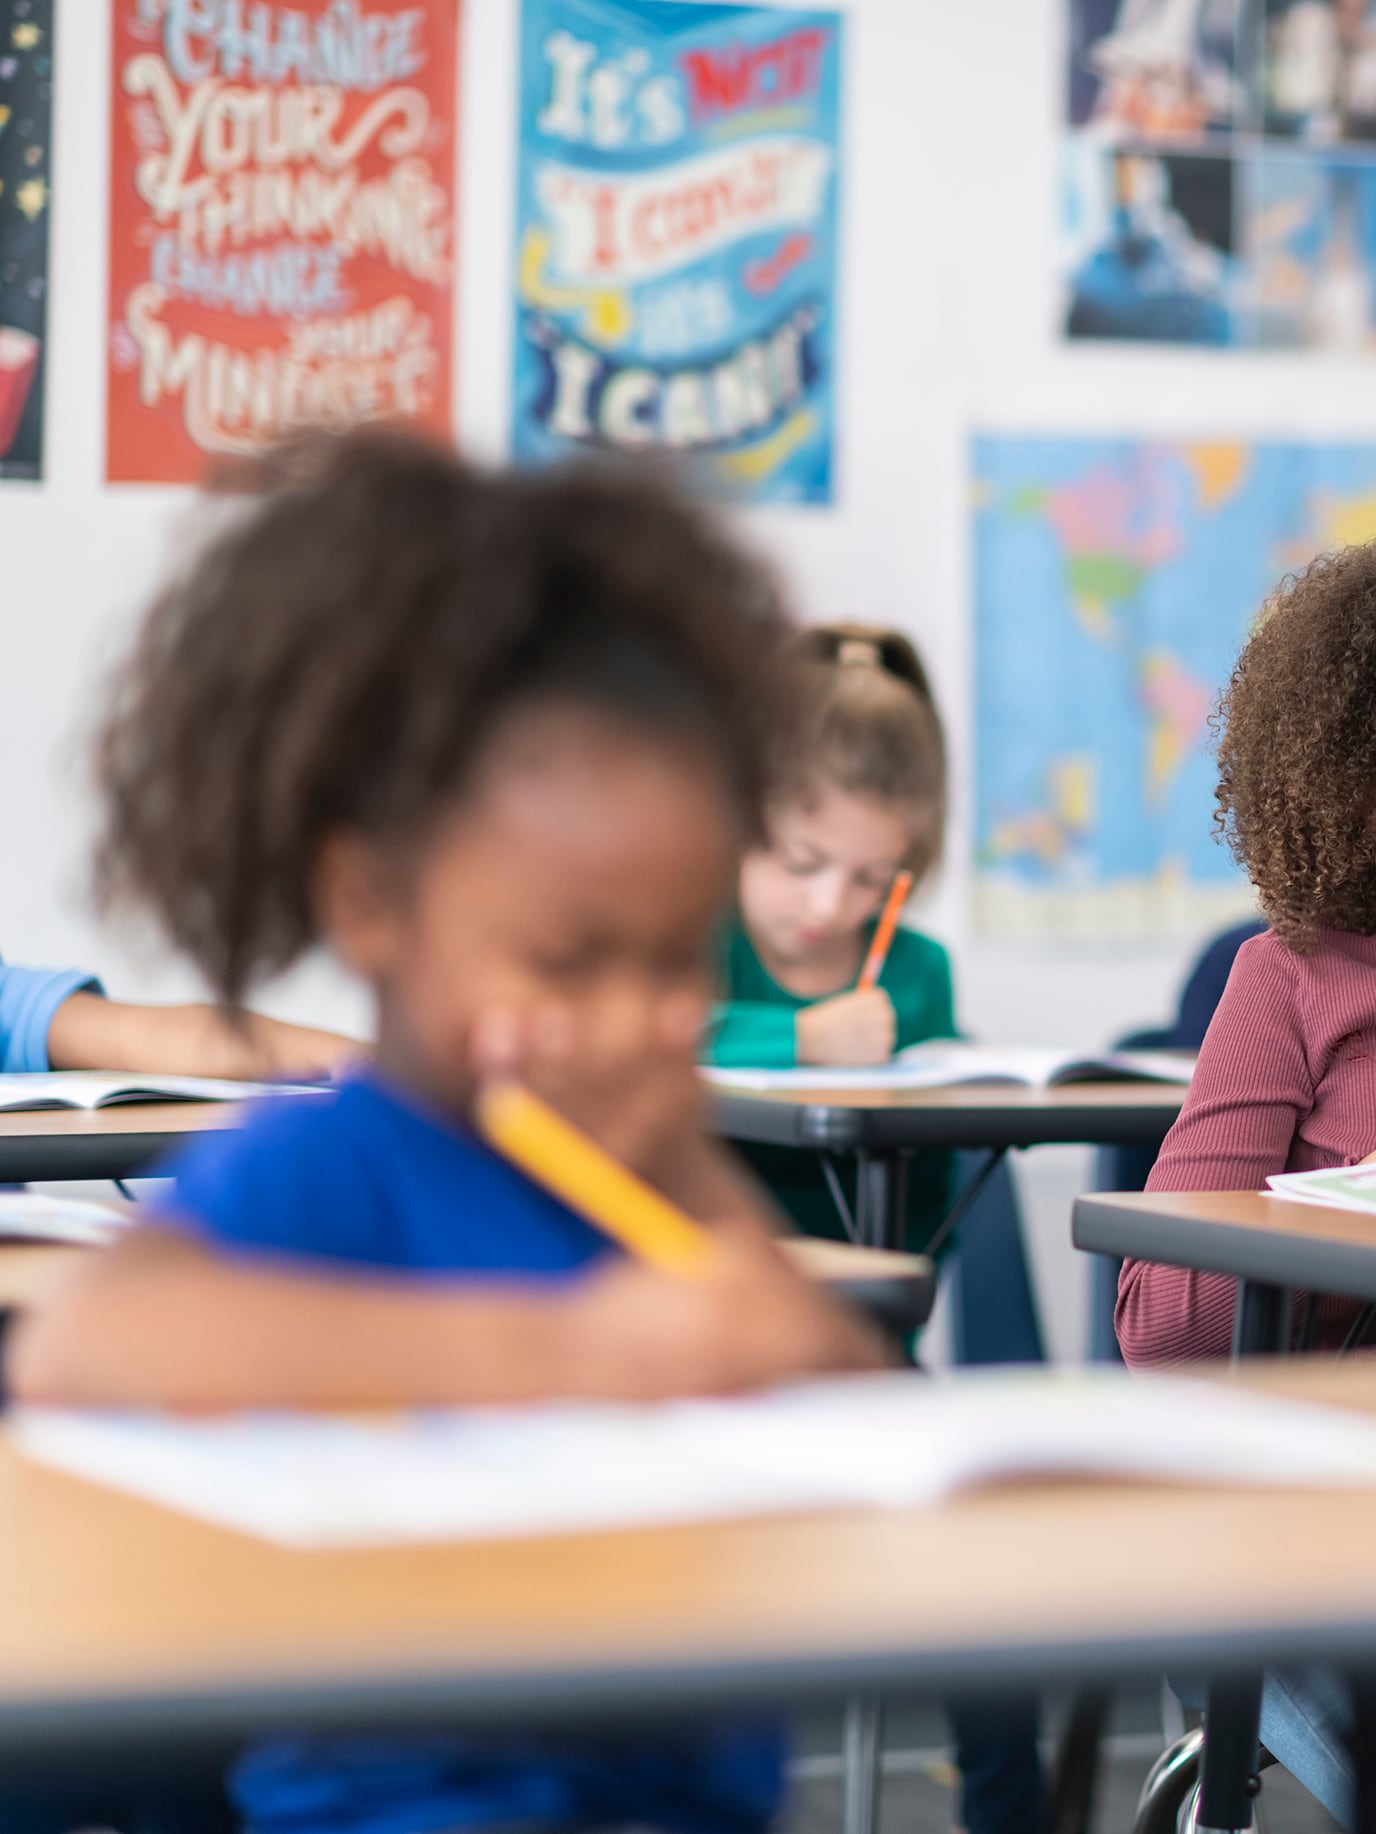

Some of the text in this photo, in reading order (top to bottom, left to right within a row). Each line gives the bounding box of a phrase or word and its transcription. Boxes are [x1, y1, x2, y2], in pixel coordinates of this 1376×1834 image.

[122, 53, 431, 208] YOUR
[680, 26, 830, 128] NOT
[160, 158, 450, 284] THINKING
[126, 284, 438, 448] MINDSET
